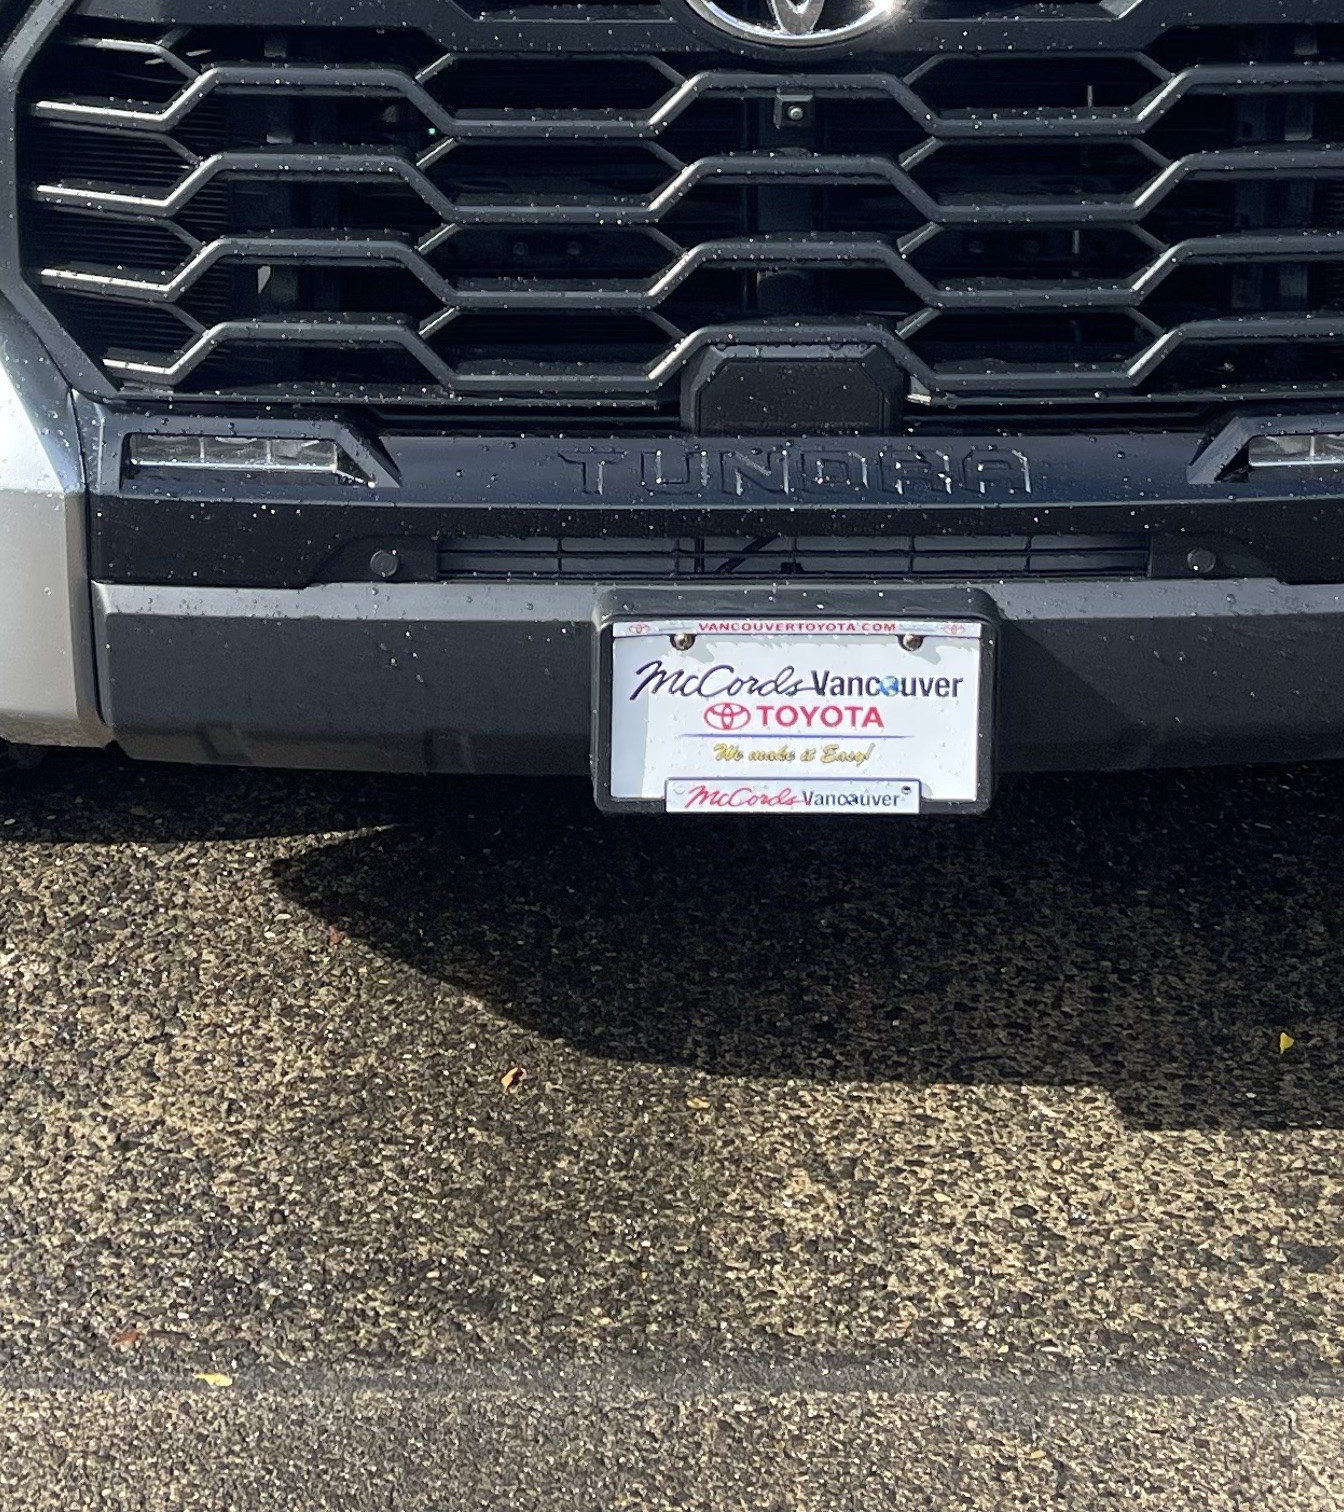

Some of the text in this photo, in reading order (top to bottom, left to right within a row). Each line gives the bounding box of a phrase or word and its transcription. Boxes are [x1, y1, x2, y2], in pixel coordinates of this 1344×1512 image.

[557, 448, 1033, 496] TUNDRA
[629, 660, 964, 701] McCords Vancouver
[756, 705, 885, 728] TOYOTA
[713, 742, 875, 766] We make it Easy!
[684, 785, 901, 809] McCords Vancouver
